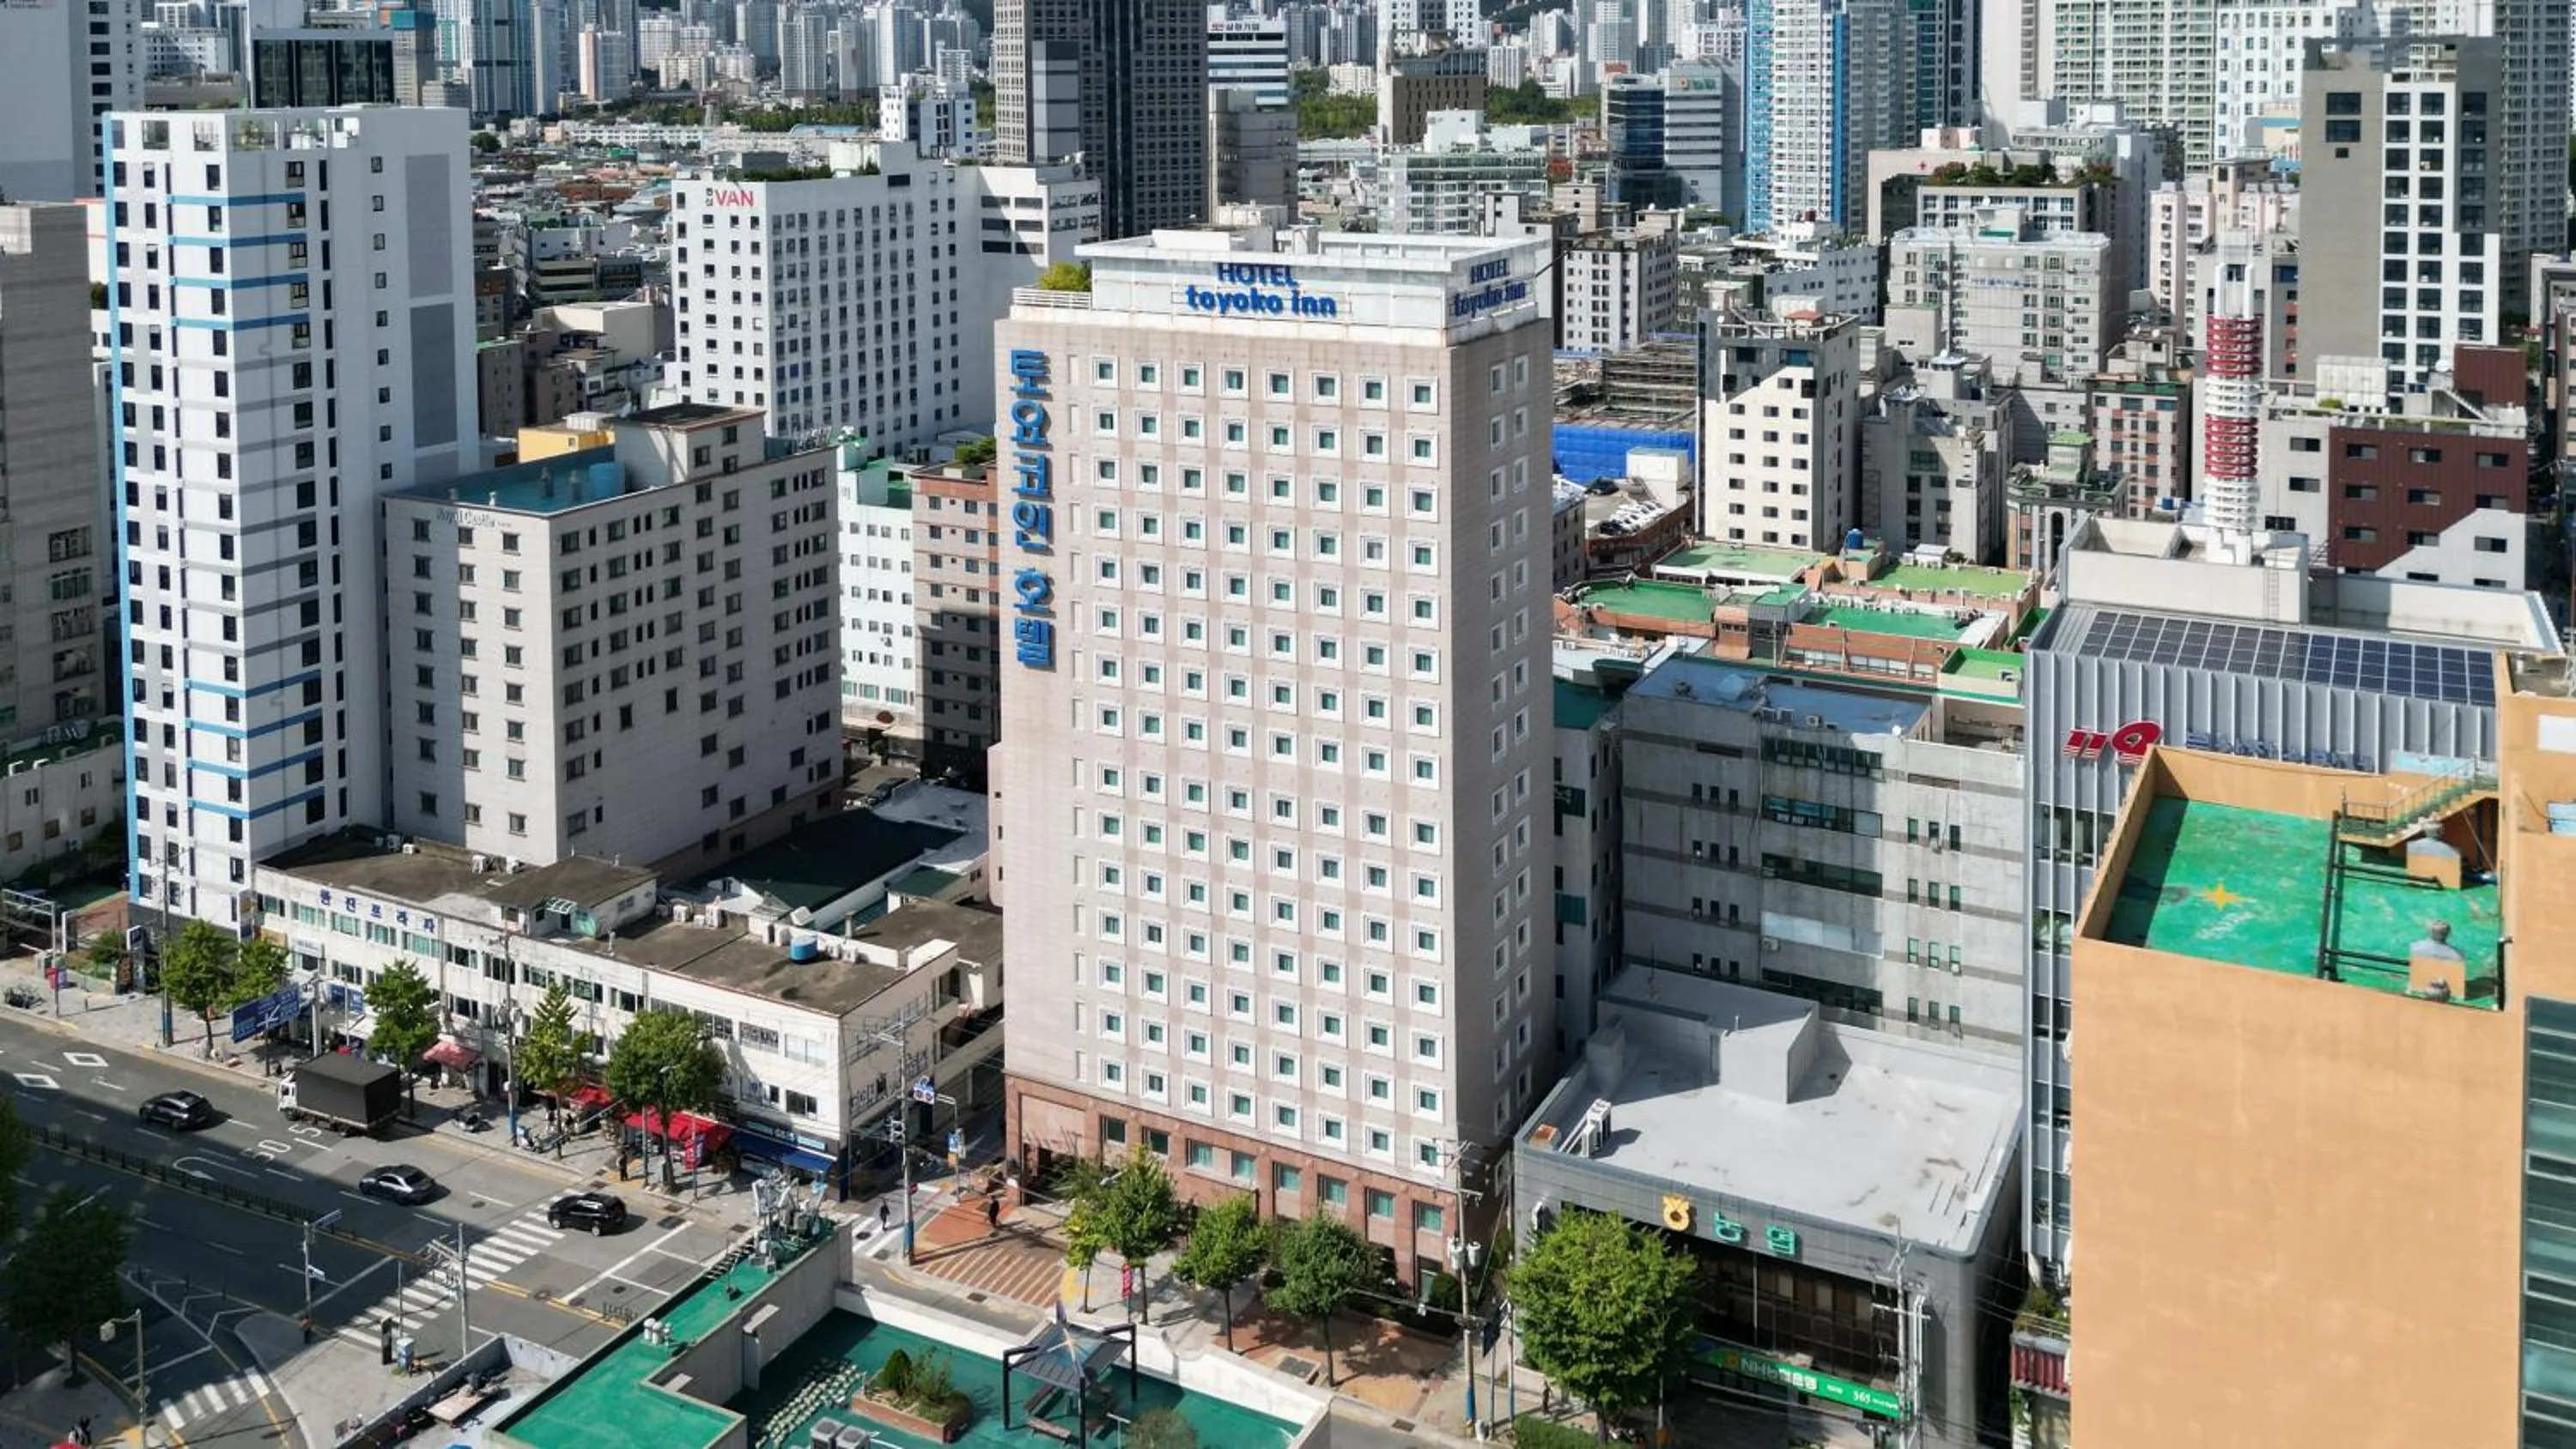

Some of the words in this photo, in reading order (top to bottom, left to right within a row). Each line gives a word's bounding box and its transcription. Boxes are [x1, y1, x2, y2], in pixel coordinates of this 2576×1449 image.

[714, 189, 754, 207] VAN
[1218, 262, 1299, 287] HOTEL
[1469, 258, 1510, 285] HOTEL
[1186, 284, 1284, 315] toyoko
[1291, 287, 1337, 318] inn
[1455, 284, 1503, 318] toyoko
[1504, 280, 1526, 303] inn
[1009, 349, 1048, 549] 토요코인
[1014, 567, 1052, 670] 호텔
[1713, 1210, 1796, 1257] 농협
